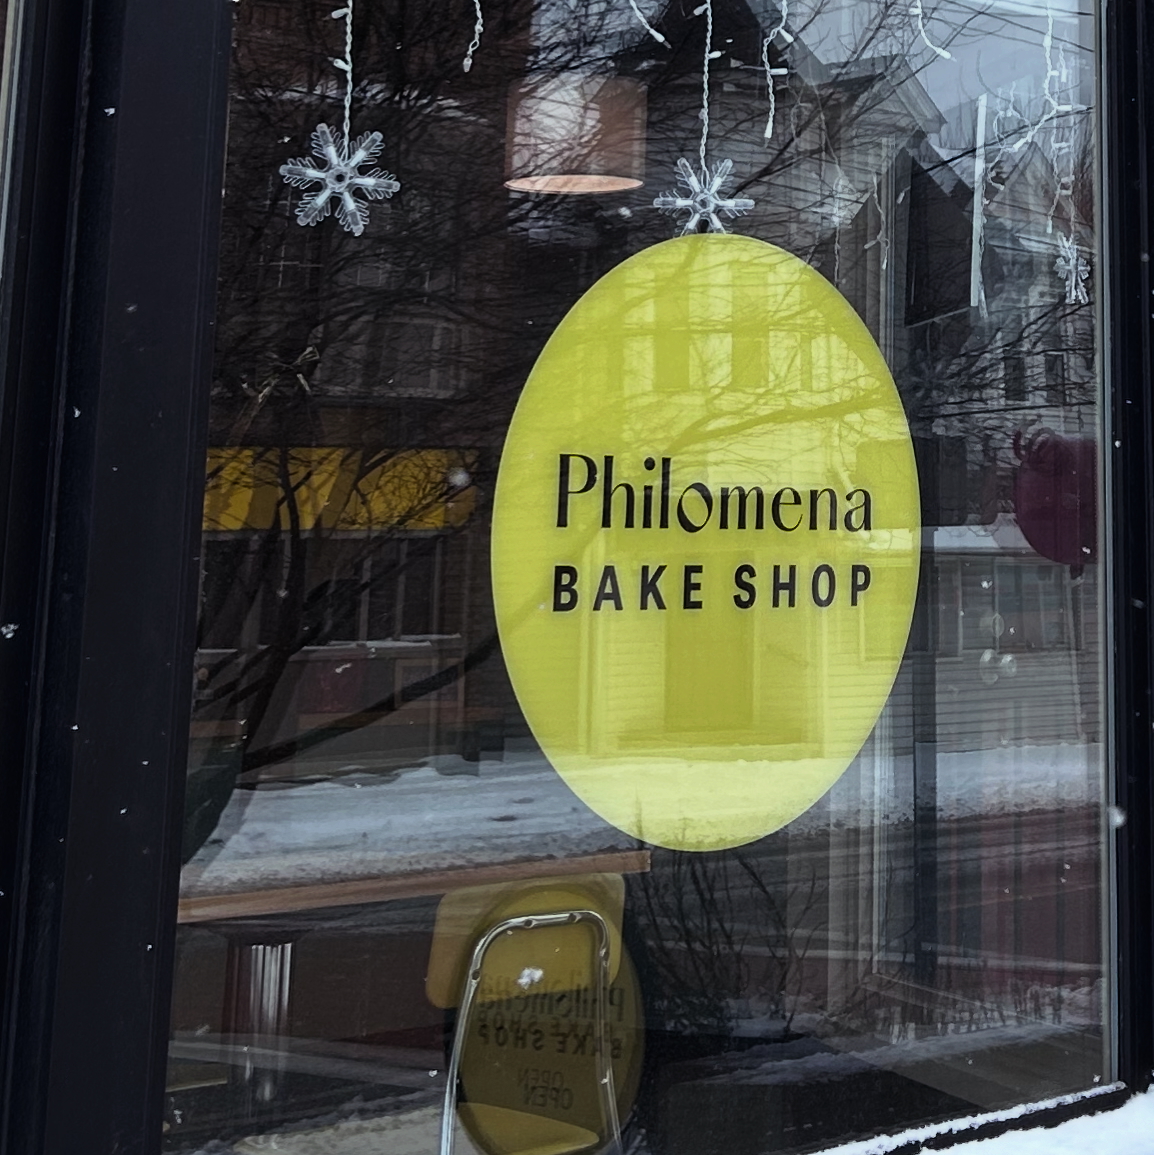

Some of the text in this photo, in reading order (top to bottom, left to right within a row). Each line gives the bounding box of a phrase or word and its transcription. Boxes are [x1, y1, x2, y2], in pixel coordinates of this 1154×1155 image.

[556, 453, 872, 533] Philomena
[552, 563, 872, 612] BAKE SHOP
